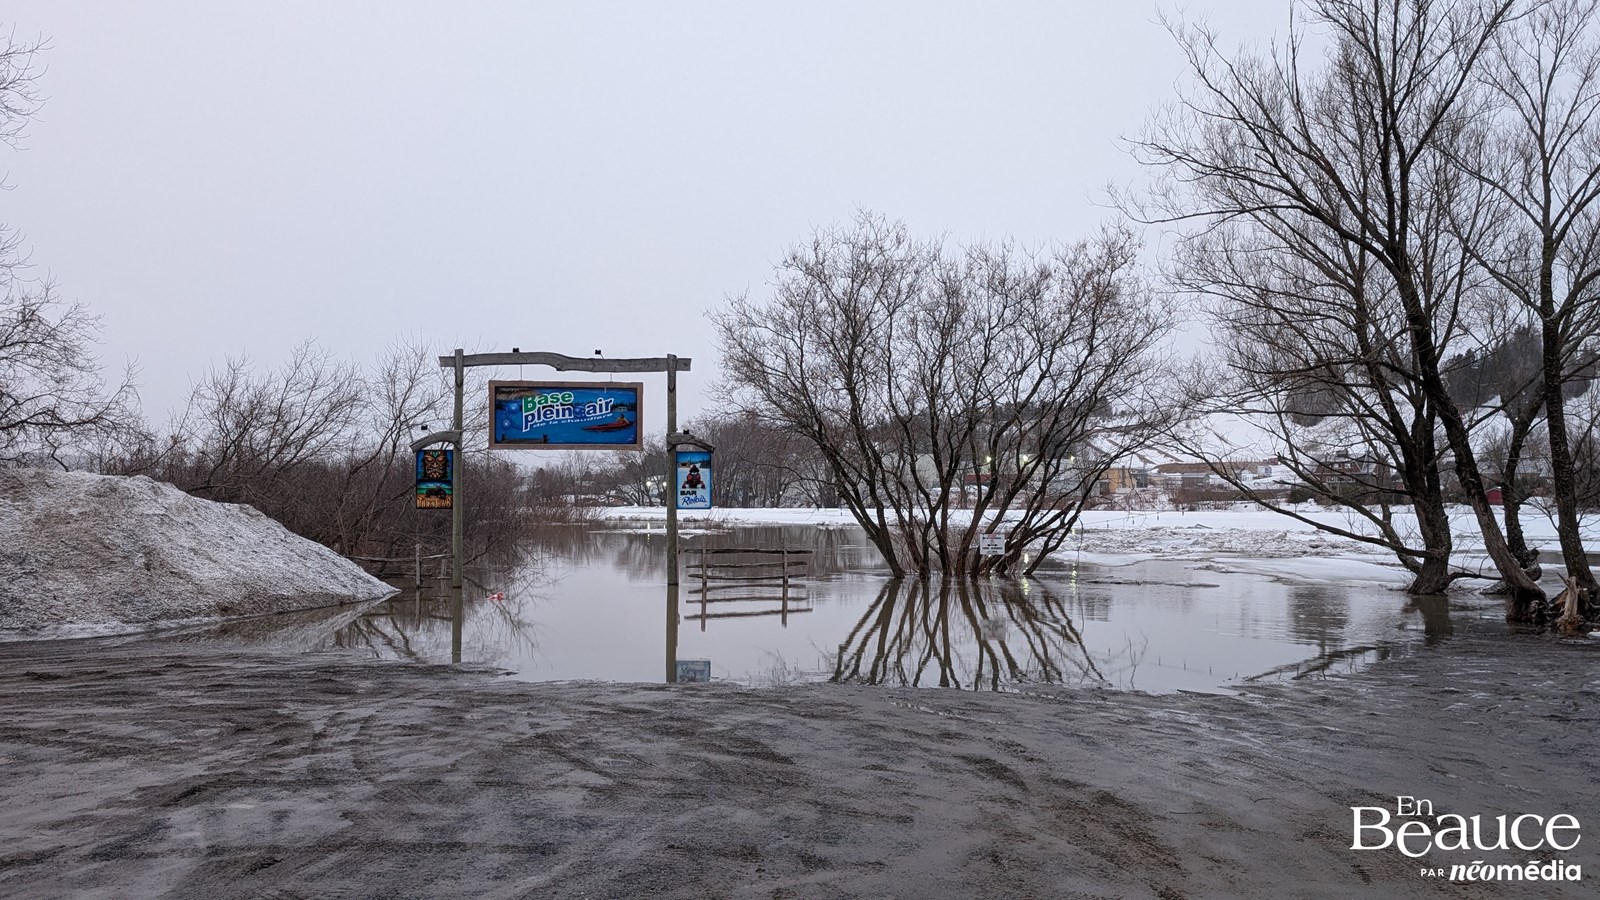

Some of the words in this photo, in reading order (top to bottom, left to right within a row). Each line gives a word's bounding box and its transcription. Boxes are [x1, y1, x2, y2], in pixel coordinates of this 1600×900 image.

[522, 404, 574, 432] plein
[585, 397, 615, 417] air
[523, 391, 574, 413] Base
